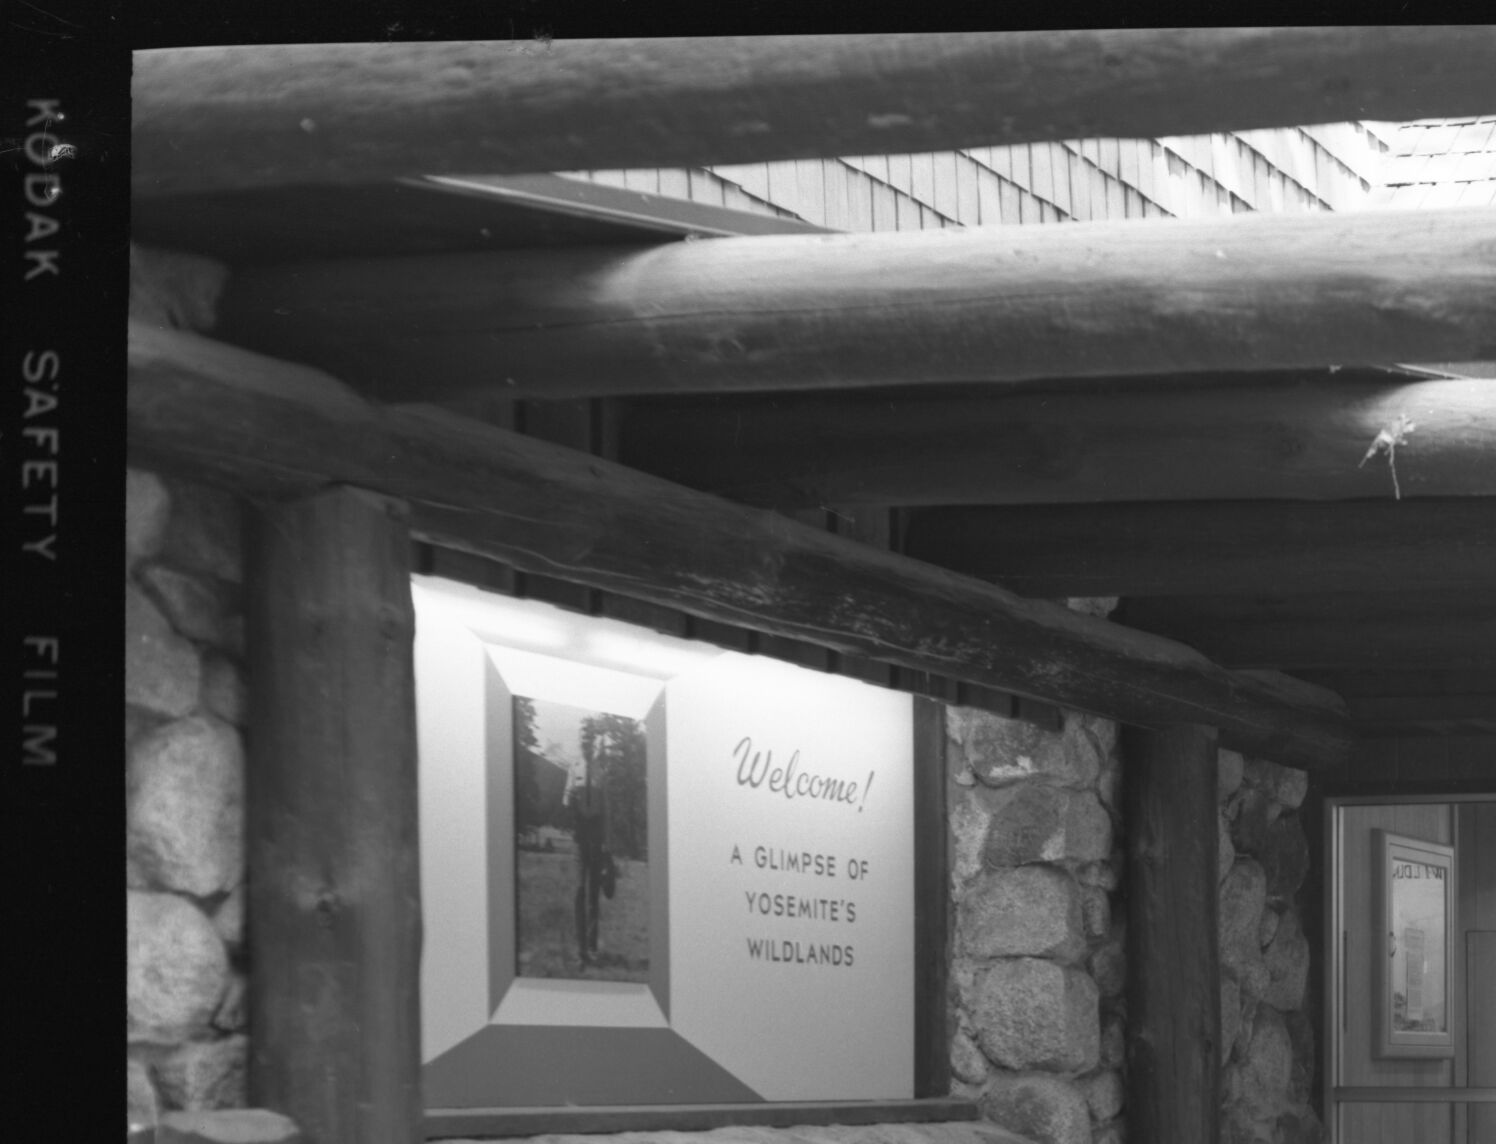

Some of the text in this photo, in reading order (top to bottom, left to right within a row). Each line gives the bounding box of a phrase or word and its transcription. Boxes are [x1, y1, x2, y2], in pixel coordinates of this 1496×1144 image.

[22, 100, 60, 765] KODAK SAFETY FILM
[732, 736, 875, 813] Welcome!
[730, 844, 870, 881] A GLIMPSE OF
[745, 890, 857, 924] YOSEMITE'S
[747, 937, 855, 968] WILDLANDS
